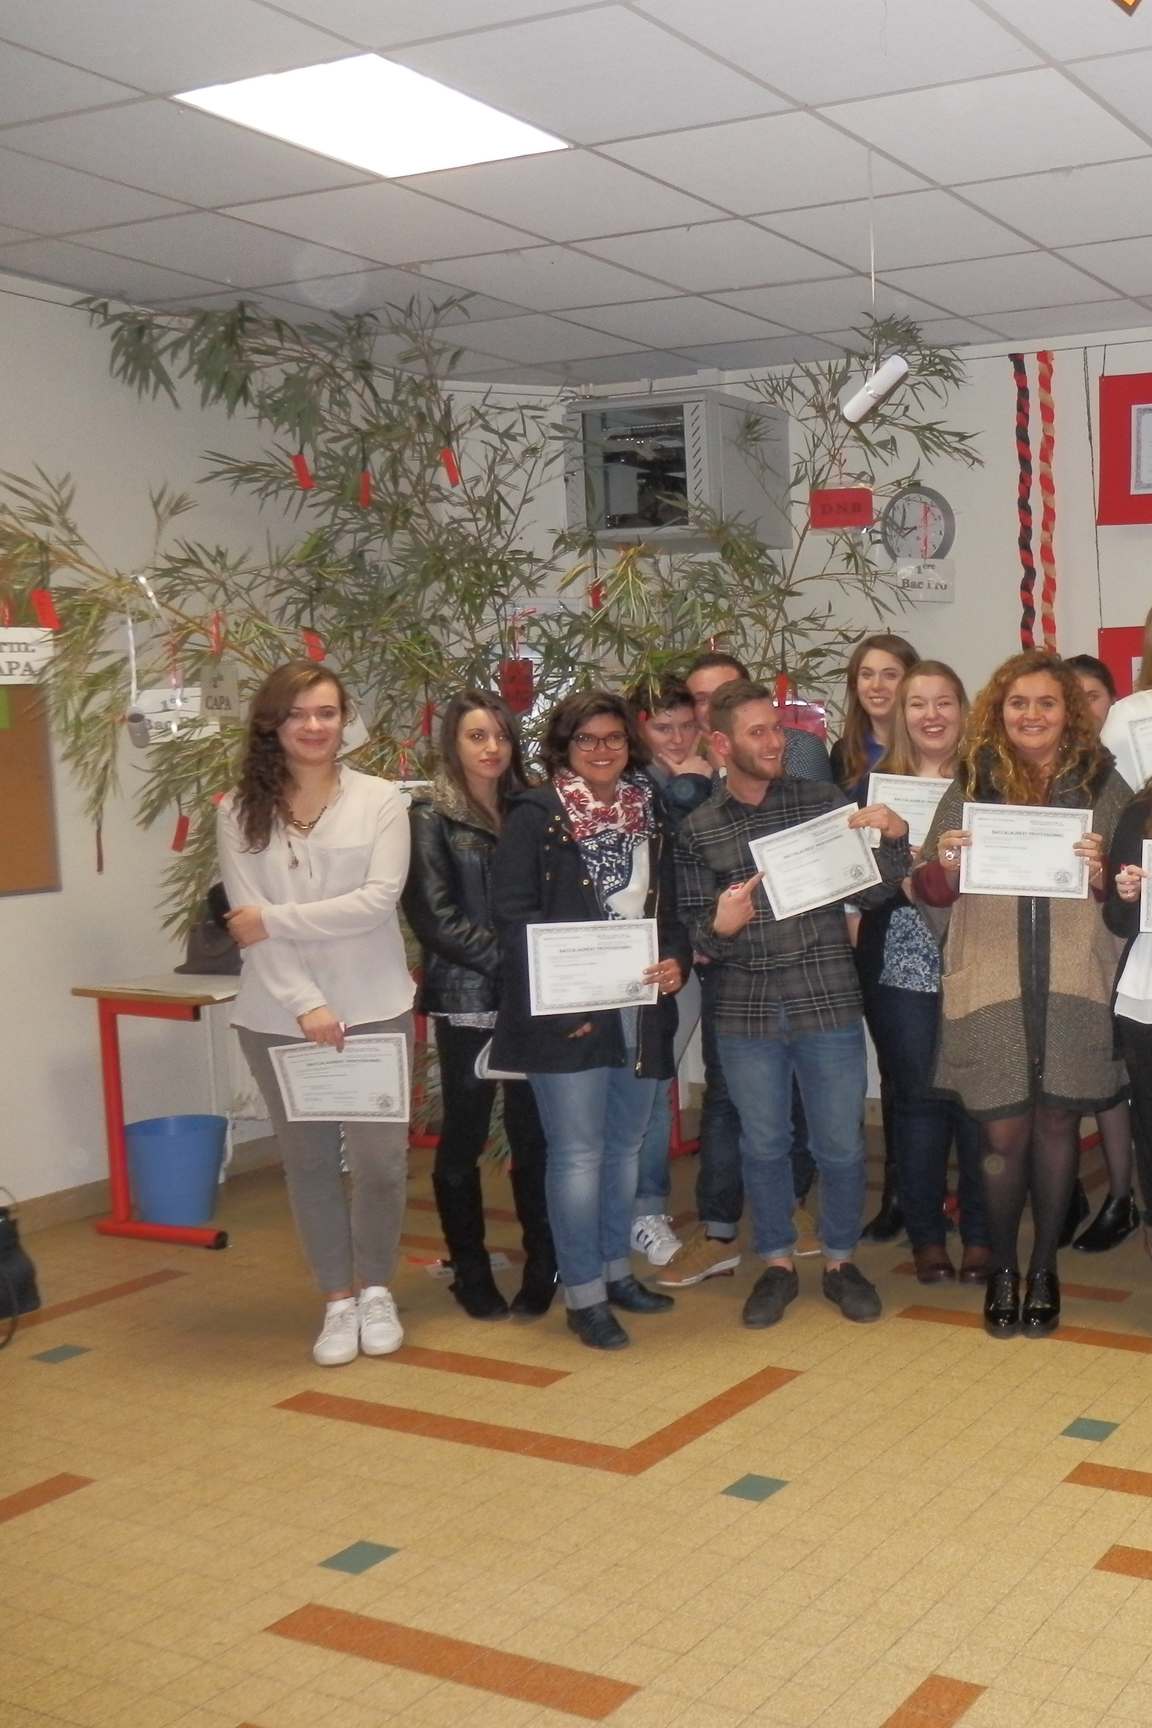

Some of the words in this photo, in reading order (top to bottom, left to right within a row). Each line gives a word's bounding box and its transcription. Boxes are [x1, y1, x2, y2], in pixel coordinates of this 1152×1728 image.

[820, 502, 863, 516] DNB
[901, 578, 924, 591] Bac
[204, 695, 234, 711] CAPA
